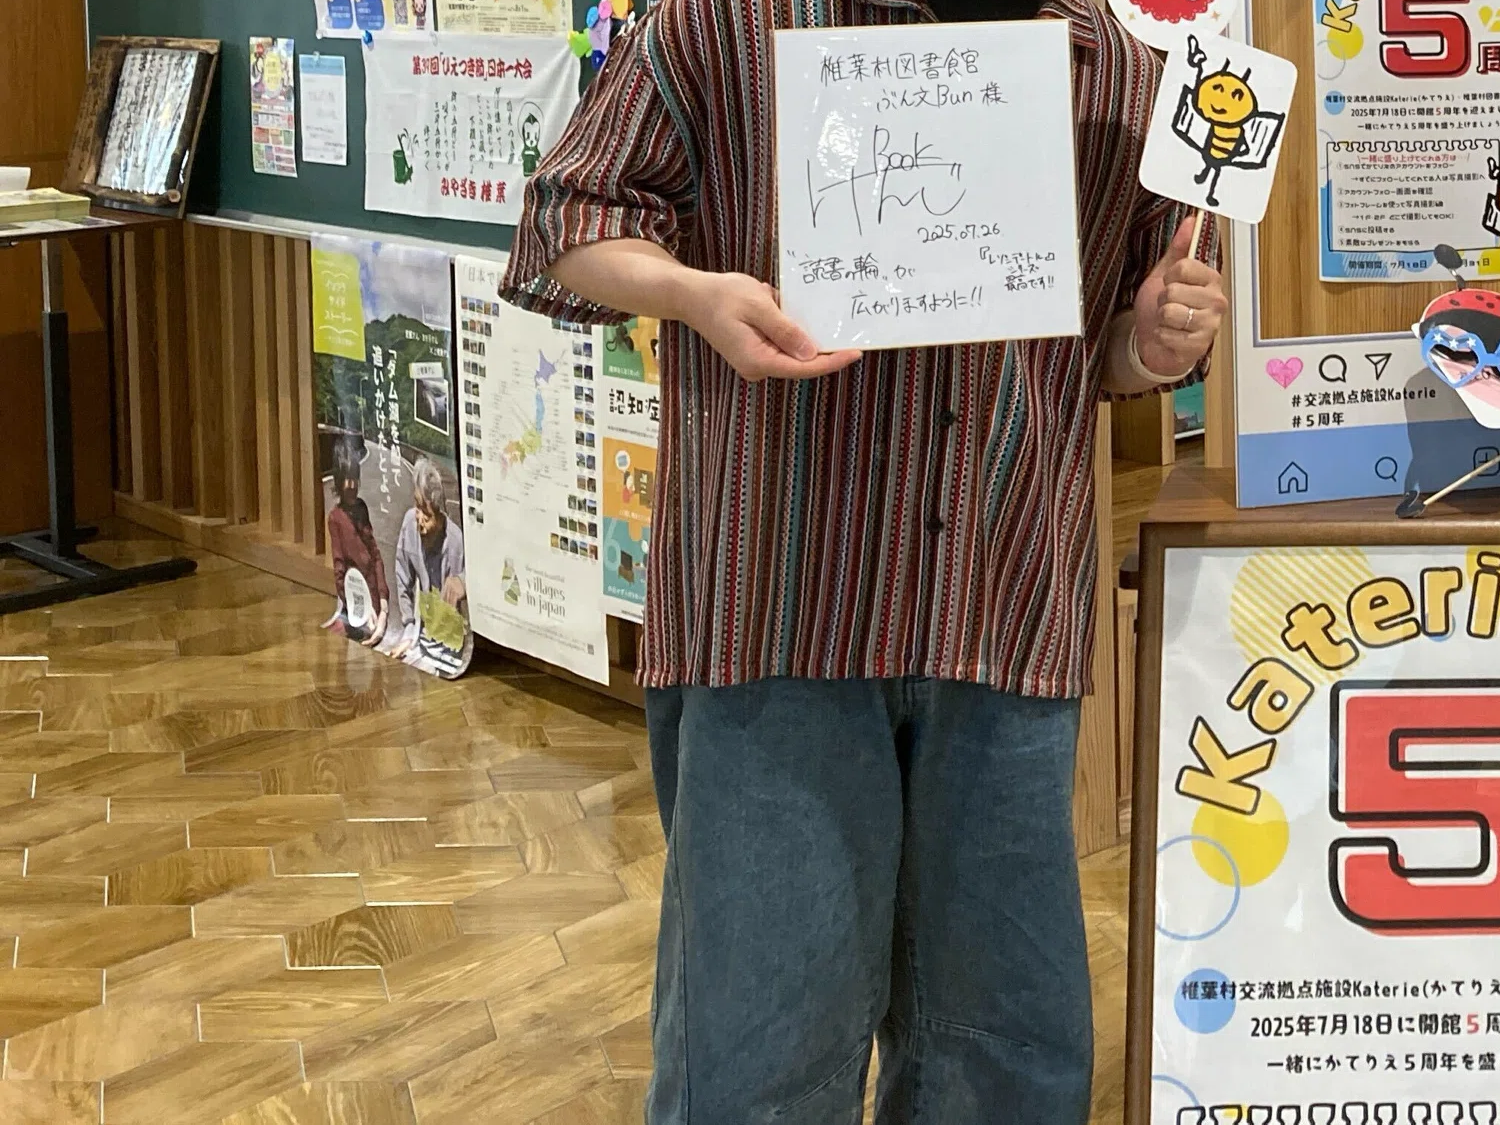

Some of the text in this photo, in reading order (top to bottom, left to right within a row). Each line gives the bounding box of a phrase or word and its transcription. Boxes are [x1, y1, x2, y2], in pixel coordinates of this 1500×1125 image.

[981, 82, 1008, 106] 様
[873, 125, 943, 173] Book
[917, 223, 1001, 244] 2025.07.26
[526, 576, 566, 601] villages
[526, 590, 566, 618] in japan
